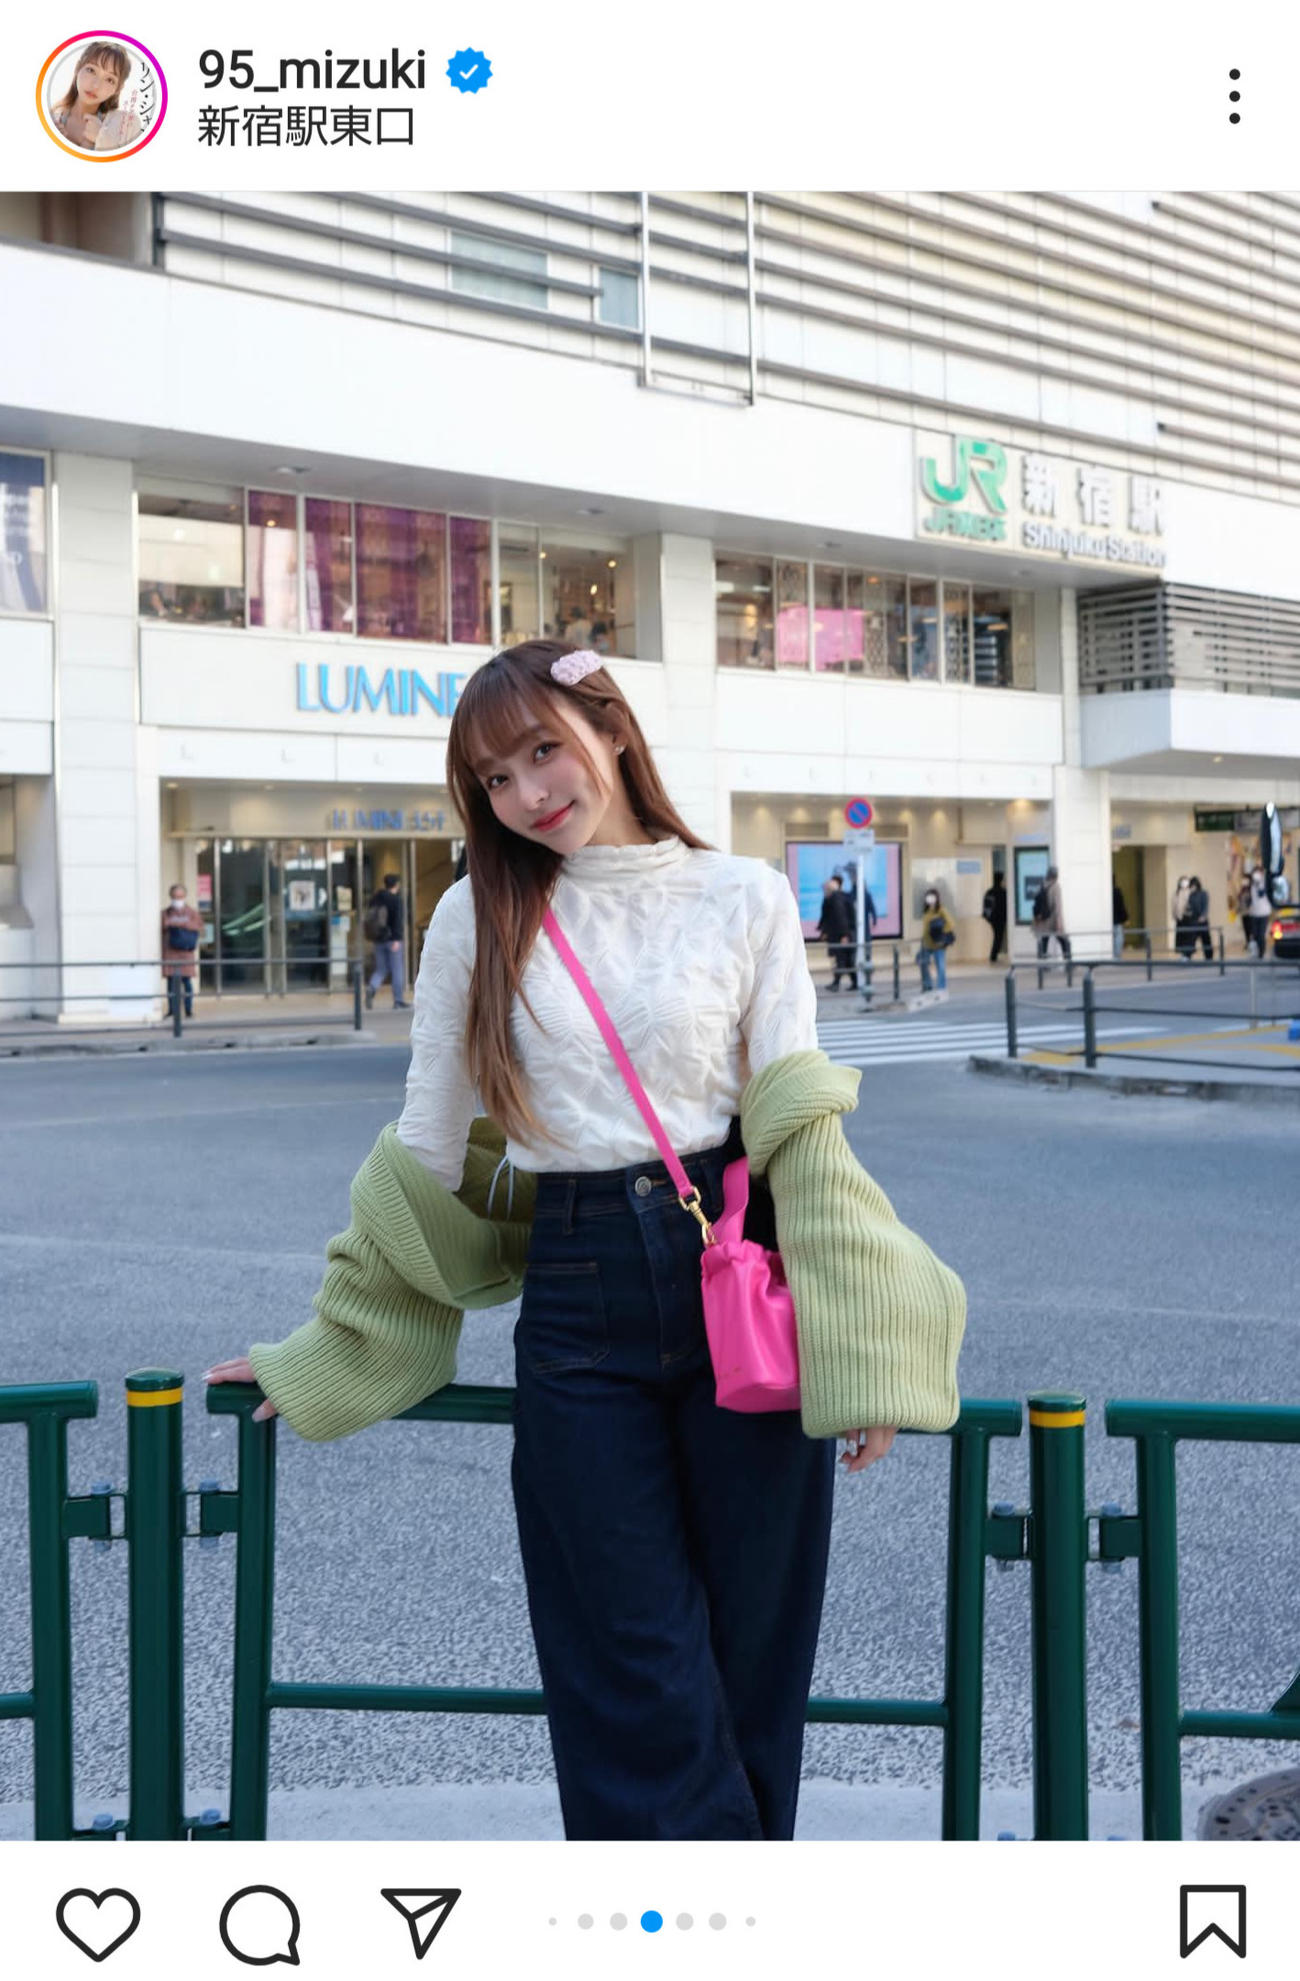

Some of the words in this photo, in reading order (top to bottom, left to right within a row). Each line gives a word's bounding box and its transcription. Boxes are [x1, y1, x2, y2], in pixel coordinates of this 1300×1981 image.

[920, 435, 1007, 514] JR
[1022, 521, 1106, 559] Shinjuku
[1106, 535, 1167, 568] Station
